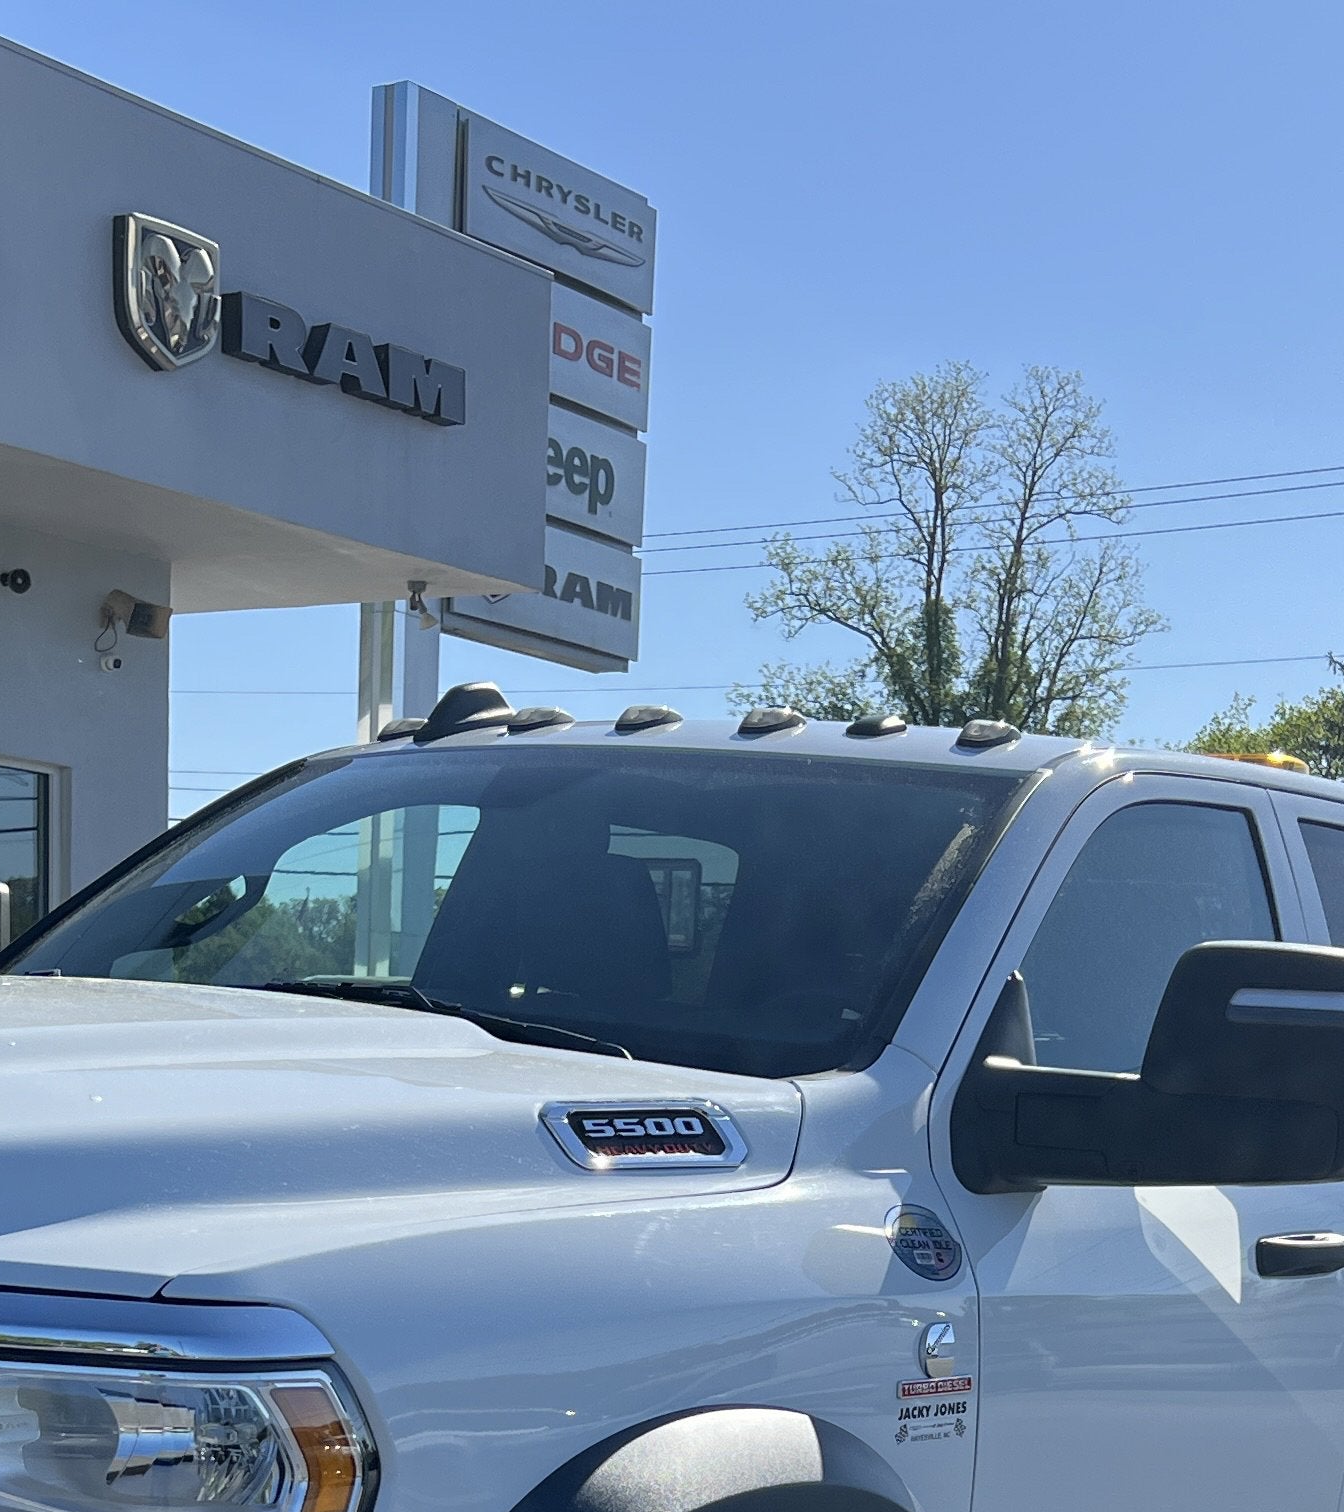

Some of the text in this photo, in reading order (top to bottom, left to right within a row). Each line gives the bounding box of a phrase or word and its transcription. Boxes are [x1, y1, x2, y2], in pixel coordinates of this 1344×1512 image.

[485, 155, 644, 243] CHRYSLER
[222, 291, 466, 426] RAM
[582, 1117, 704, 1138] 5500
[899, 1238, 931, 1250] CLEAN
[903, 1379, 971, 1396] TURBO DIESEL
[898, 1401, 968, 1421] JACKY JONES
